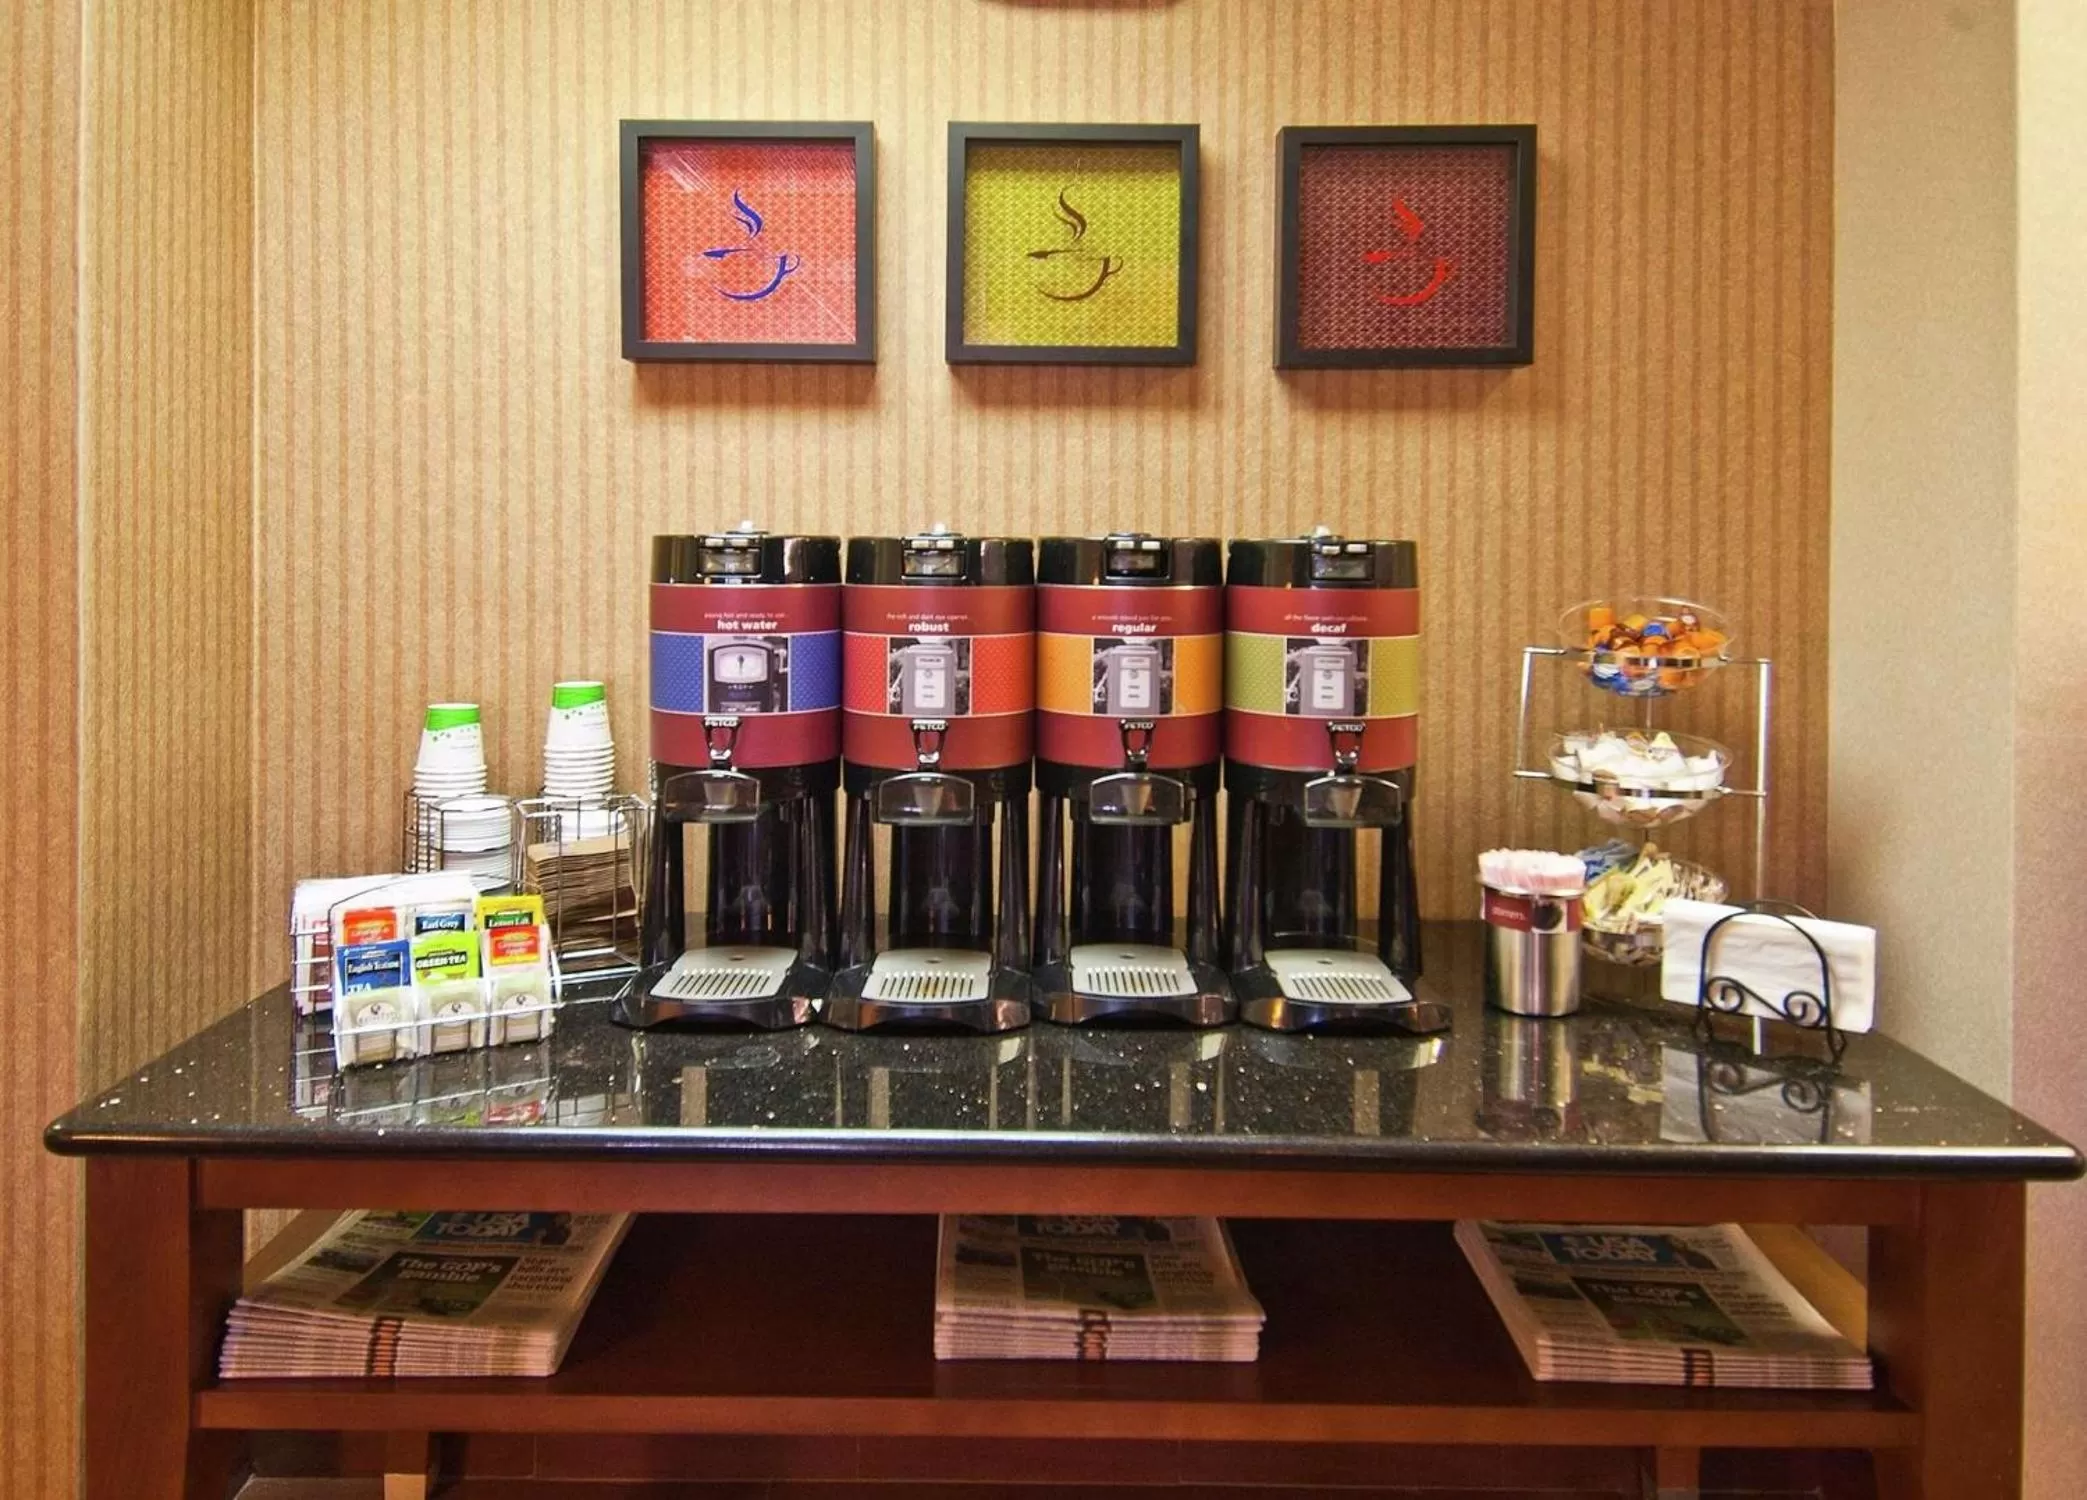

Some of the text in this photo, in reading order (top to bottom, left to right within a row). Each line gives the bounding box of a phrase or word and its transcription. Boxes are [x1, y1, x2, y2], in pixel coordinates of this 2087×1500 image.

[717, 619, 778, 630] hot water
[908, 621, 949, 632] robust
[1112, 622, 1157, 635] regular
[1310, 622, 1347, 633] decaf
[422, 917, 460, 930] Earl Grey
[416, 954, 467, 969] GREEN TEA
[435, 1222, 523, 1237] TODAY
[397, 1258, 438, 1270] The
